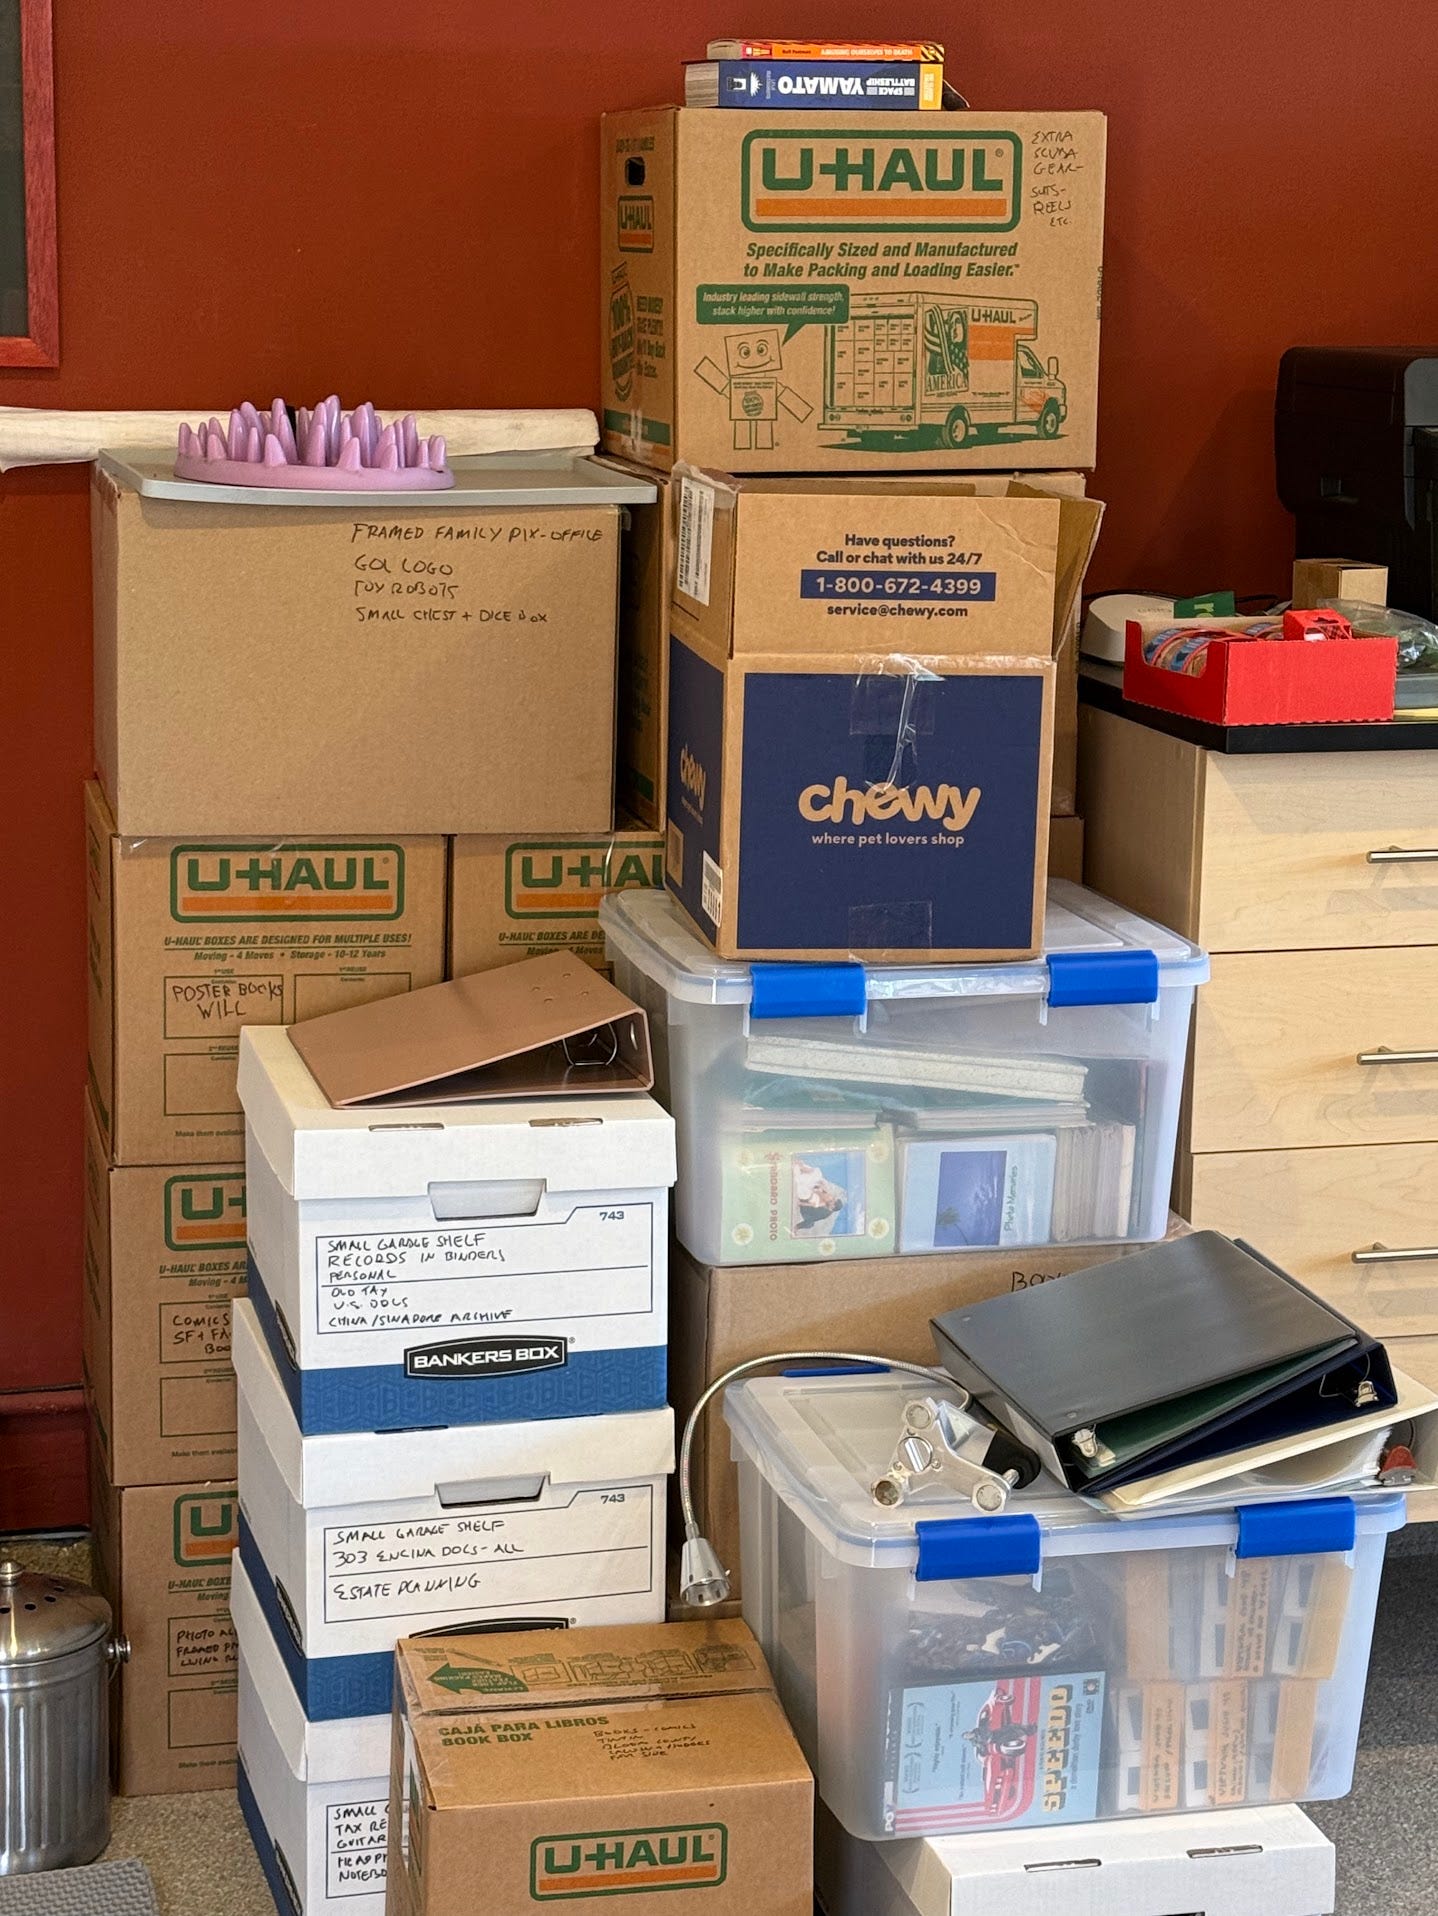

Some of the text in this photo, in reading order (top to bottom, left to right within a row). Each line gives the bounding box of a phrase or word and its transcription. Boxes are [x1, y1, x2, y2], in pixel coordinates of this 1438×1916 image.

[778, 76, 864, 96] YAMATO
[865, 77, 916, 86] BATTLESHIP
[879, 86, 904, 95] SPACE
[1031, 130, 1073, 144] EXTRA
[762, 148, 1004, 191] U-HAUL
[746, 241, 1018, 260] Specifically Sized and Manufactured
[743, 263, 758, 278] to
[763, 262, 804, 278] Make
[807, 262, 867, 281] Packing
[871, 262, 900, 278] and
[903, 263, 962, 281] Loading
[702, 292, 738, 303] Industry
[740, 292, 770, 303] leading
[772, 292, 806, 302] sidewall
[712, 305, 736, 316] stack
[738, 305, 764, 317] higher
[766, 305, 785, 316] with
[971, 308, 1017, 324] U-HAUL
[351, 523, 503, 544] FRAMED FAMILY
[845, 533, 956, 550] Have questions?
[816, 550, 983, 566] Call or chat with us 24/7
[401, 557, 454, 576] LOGO
[816, 576, 982, 595] 1-800-672-4399
[355, 606, 405, 622] SMALL
[827, 603, 969, 620] service@chewy.com
[680, 743, 706, 812] chewy
[798, 775, 982, 832] chewy
[812, 832, 965, 848] where pet lovers shop
[187, 857, 390, 892] U-HAUL
[203, 935, 237, 946] BOXES
[238, 935, 260, 945] ARE
[261, 934, 310, 945] DESIGNED
[312, 934, 332, 944] FOR
[334, 933, 381, 944] MULTIPLE
[382, 932, 412, 943] USES!
[536, 931, 567, 941] BOXES
[569, 930, 589, 940] ARE
[194, 951, 227, 961] Moving
[245, 951, 274, 960] Moves
[290, 949, 325, 960] Storage
[335, 949, 359, 959] 10-12
[362, 948, 386, 958] Years
[172, 980, 284, 1003] POSTER BOOKS
[197, 998, 247, 1020] WILL
[599, 1210, 625, 1222] 743
[327, 1239, 371, 1254] SMALL
[436, 1233, 487, 1249] SHELF
[197, 1261, 231, 1272] BOXES
[231, 1260, 248, 1271] AR
[327, 1251, 407, 1268] RECORDS
[420, 1252, 436, 1264] IN
[188, 1276, 222, 1287] Moving
[328, 1269, 398, 1284] PERSONAL
[172, 1312, 230, 1328] COMICS
[450, 1308, 514, 1323] ARCHIVE
[173, 1329, 196, 1344] SF
[211, 1327, 232, 1341] FA
[204, 1343, 232, 1354] BOO
[413, 1345, 560, 1369] BANKERS BOX
[600, 1493, 626, 1505] 743
[333, 1530, 386, 1546] SMALL
[457, 1520, 505, 1533] SHELF
[333, 1550, 367, 1568] 303
[207, 1575, 231, 1587] BOXE
[333, 1572, 482, 1600] ESTATE PLANNING
[177, 1629, 215, 1644] PHOTO
[490, 1721, 540, 1733] PARA
[544, 1715, 610, 1730] LIBROS
[441, 1732, 534, 1748] BOOK BOX
[1041, 1684, 1073, 1813] SPEEDO
[333, 1805, 377, 1821] SMALL
[335, 1818, 388, 1836] TAX RE
[336, 1833, 387, 1849] GUITAR
[543, 1834, 716, 1875] U-HAUL
[338, 1867, 388, 1883] NOTEBO
